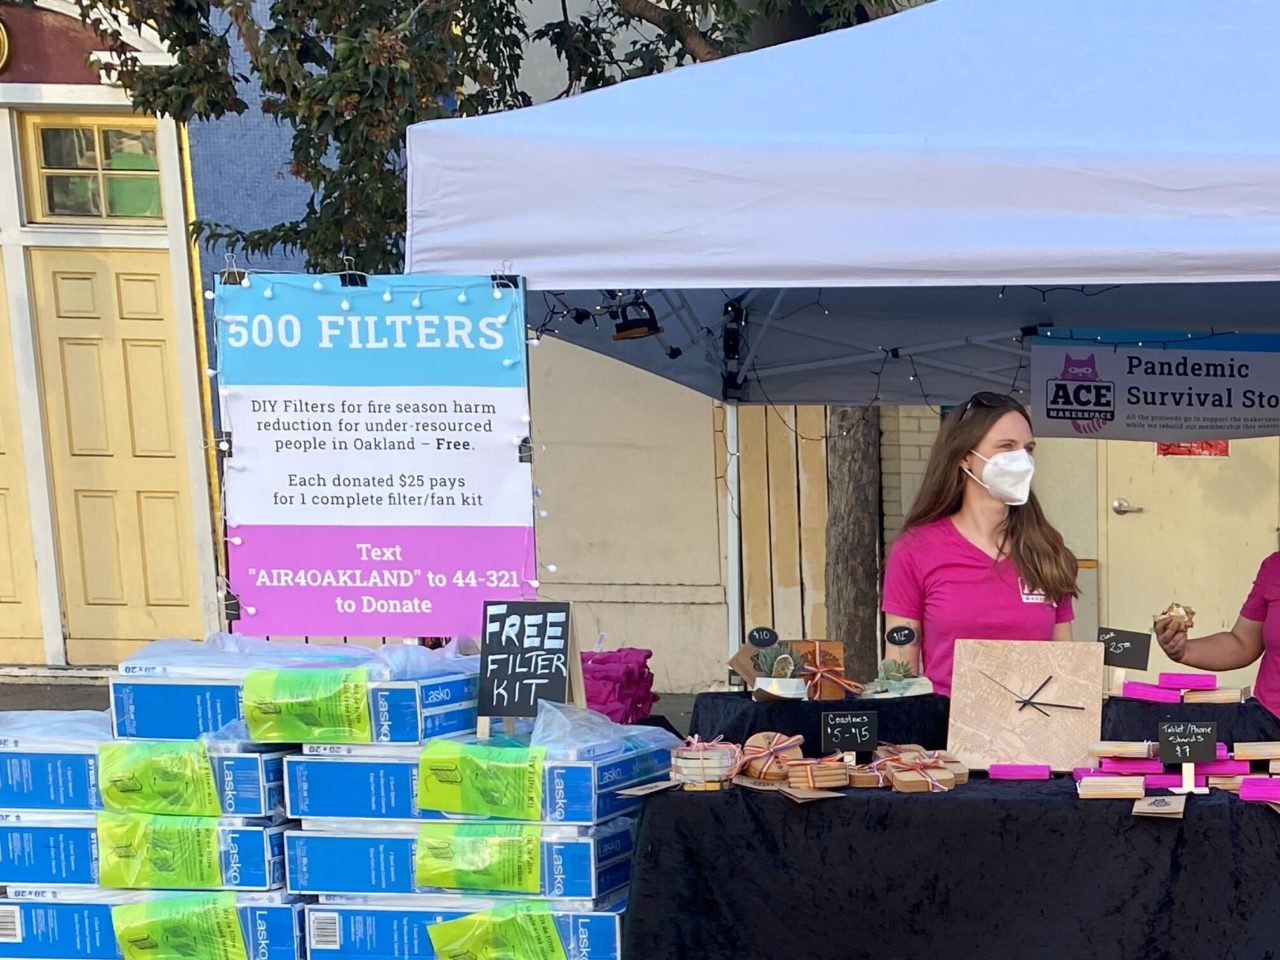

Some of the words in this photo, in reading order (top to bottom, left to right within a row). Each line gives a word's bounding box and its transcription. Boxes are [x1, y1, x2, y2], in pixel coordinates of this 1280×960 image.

[227, 314, 301, 348] 500
[317, 315, 504, 350] FILTERS
[1126, 356, 1250, 379] Pandemic
[251, 400, 279, 413] DIY
[283, 399, 335, 413] Filters
[341, 400, 362, 413] for
[367, 400, 392, 413] fire
[396, 403, 448, 414] season
[453, 401, 496, 414] harm
[1050, 384, 1112, 408] ACE
[1126, 386, 1233, 409] Survival
[257, 419, 332, 432] reduction
[338, 419, 360, 432] for
[365, 419, 493, 433] under-resourced
[1050, 410, 1113, 420] MAKERSPACE
[1198, 423, 1241, 431] membership
[275, 438, 327, 453] people
[331, 437, 348, 451] in
[353, 437, 415, 451] Oakland
[435, 438, 476, 451] Free.
[288, 474, 327, 488] Each
[332, 474, 394, 488] donated
[398, 473, 424, 489] $25
[429, 477, 466, 491] pays
[273, 492, 295, 506] for
[300, 493, 307, 506] 1
[311, 493, 384, 509] complete
[387, 492, 456, 507] filter/fan
[461, 493, 483, 507] kit
[356, 543, 403, 561] Text
[248, 568, 422, 588] "AIR4OAKLAND"
[427, 571, 447, 588] to
[452, 570, 520, 588] 44-321
[336, 597, 356, 614] to
[361, 597, 433, 614] Donate
[486, 604, 567, 650] FREE
[487, 651, 567, 679] FILTER
[423, 686, 451, 704] Lasko
[493, 679, 550, 707] KIT
[377, 691, 391, 744] Lasko
[223, 760, 235, 812] Lasko
[553, 769, 566, 821] Lasko
[229, 833, 241, 884] Lasko
[552, 844, 565, 896] Lasko
[255, 910, 269, 960] Lasko
